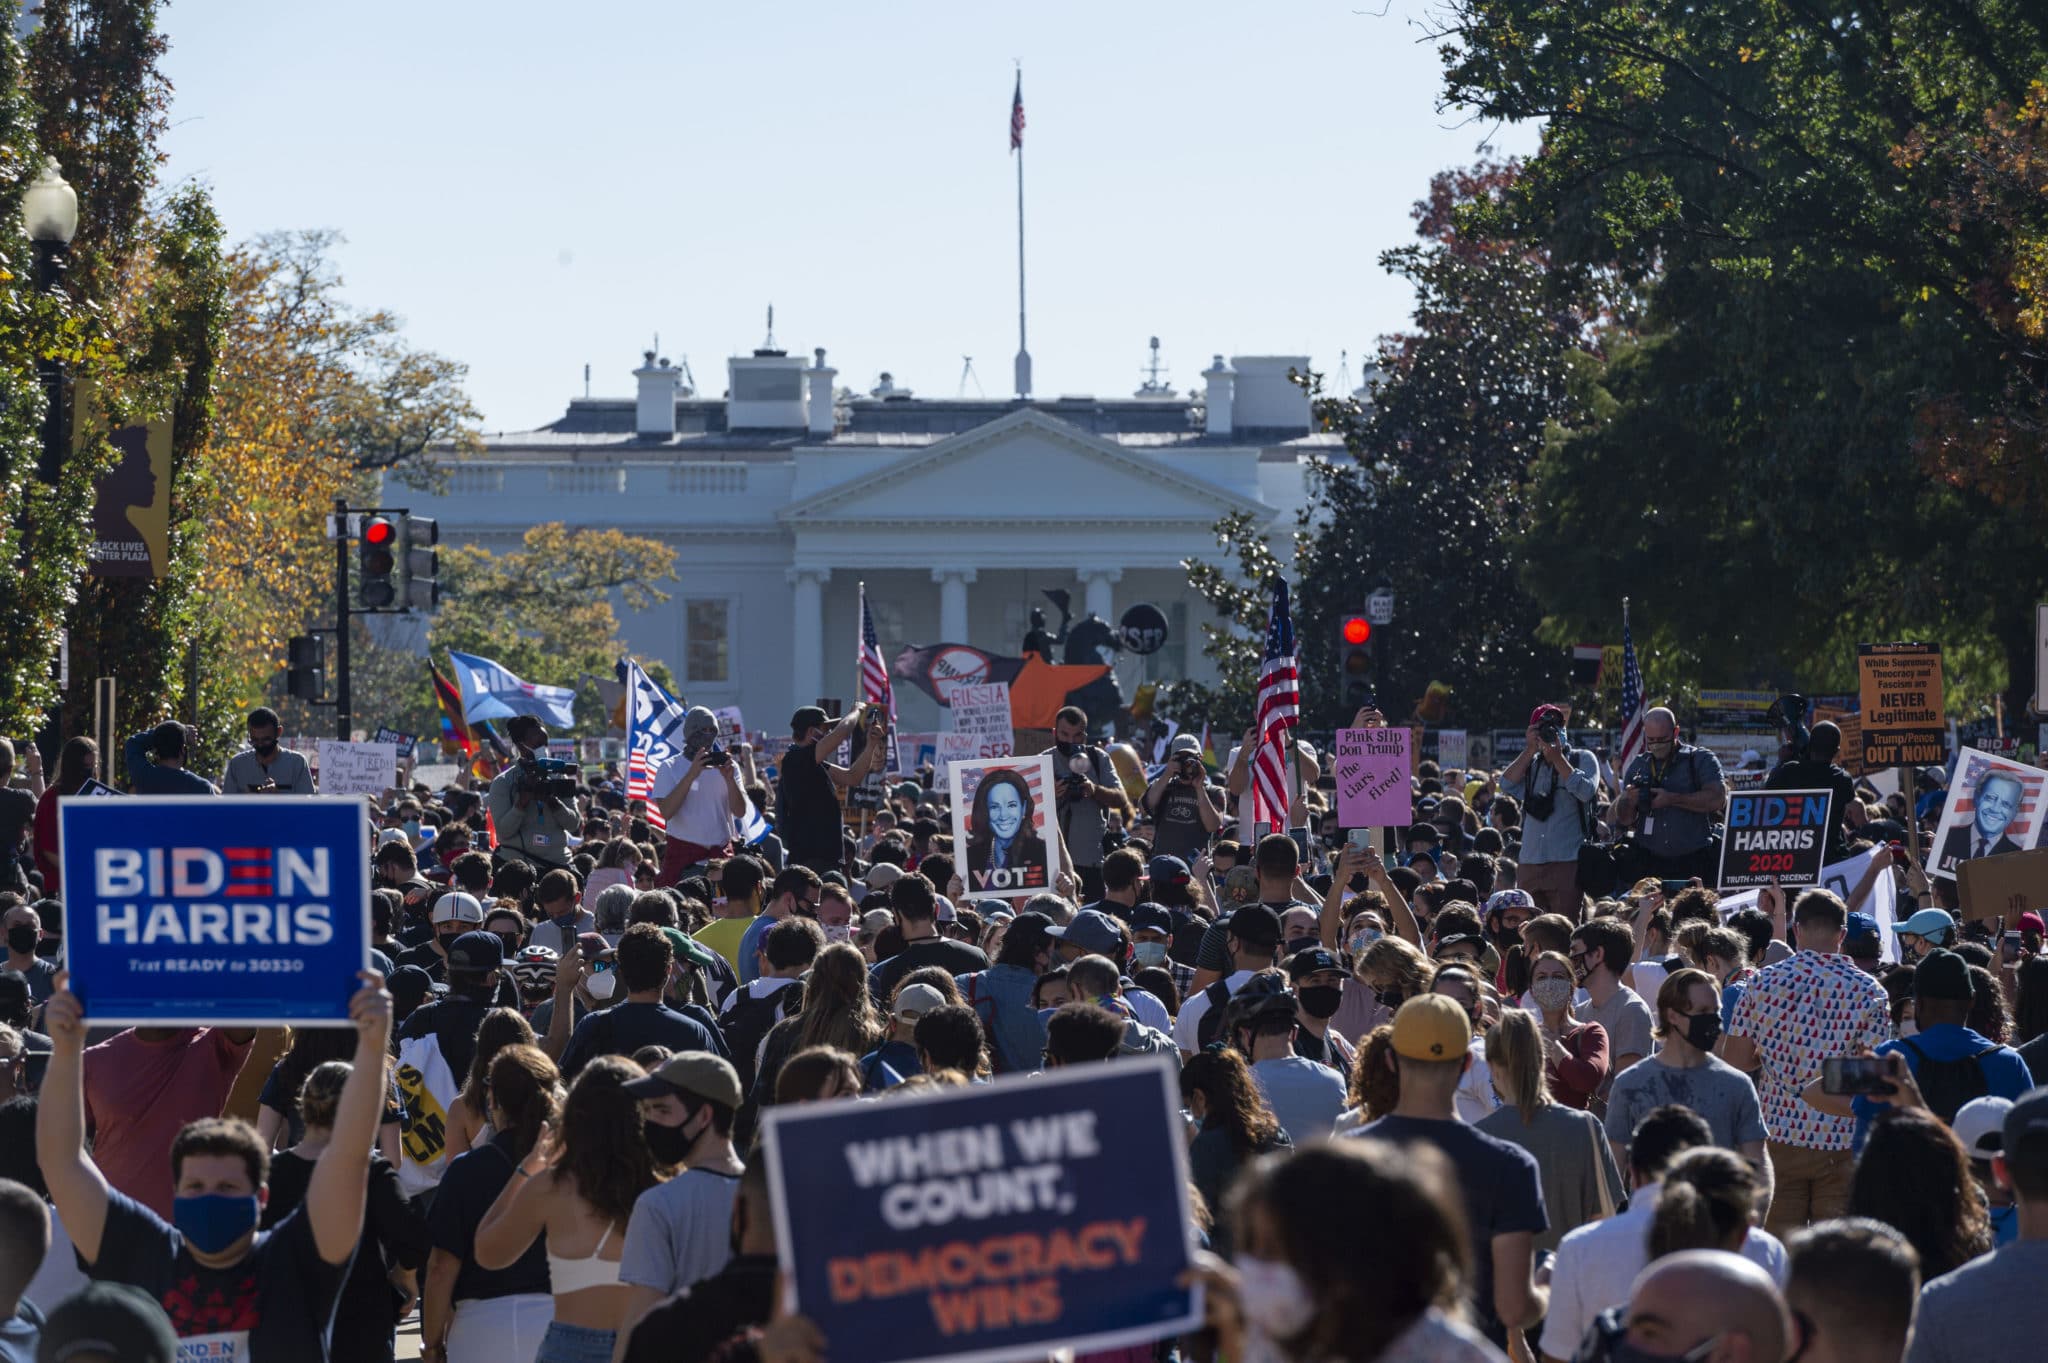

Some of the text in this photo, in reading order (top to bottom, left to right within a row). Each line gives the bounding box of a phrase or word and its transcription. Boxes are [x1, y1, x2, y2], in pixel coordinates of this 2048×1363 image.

[121, 542, 145, 551] LIVES
[122, 551, 149, 561] PLAZA
[1865, 659, 1889, 668] White
[1873, 669, 1931, 679] Theocracy and
[1878, 681, 1912, 689] Fascism
[952, 685, 1004, 708] RUSSIA
[1881, 692, 1926, 708] NEVER
[1870, 709, 1937, 725] Legitimate
[379, 727, 414, 745] BIDEN
[944, 735, 974, 751] NOW
[1345, 730, 1402, 744] Pink Slip
[1873, 733, 1935, 746] Trump/Pence
[1977, 738, 2020, 750] BIDEN
[1340, 744, 1404, 757] Don Trump
[1866, 745, 1942, 763] OUT NOW!
[327, 769, 343, 781] Stop
[1340, 762, 1360, 779] The
[1344, 772, 1375, 799] Liars
[1368, 767, 1402, 800] Fired!
[1730, 796, 1827, 827] BIDEN
[1734, 829, 1815, 851] HARRIS
[1749, 854, 1794, 872] 2020
[95, 847, 330, 897] BIDEN
[972, 865, 1044, 889] VOTE
[1726, 875, 1750, 884] TRUTH
[1780, 873, 1814, 882] DECENCY
[96, 904, 333, 944] HARRIS
[165, 959, 226, 972] READY
[230, 960, 246, 972] to
[249, 959, 304, 972] 30330
[845, 1109, 1101, 1187] WHEN WE
[880, 1164, 1076, 1230] COUNT,
[826, 1217, 1147, 1304] DEMOCRACY
[929, 1278, 1064, 1336] WINS
